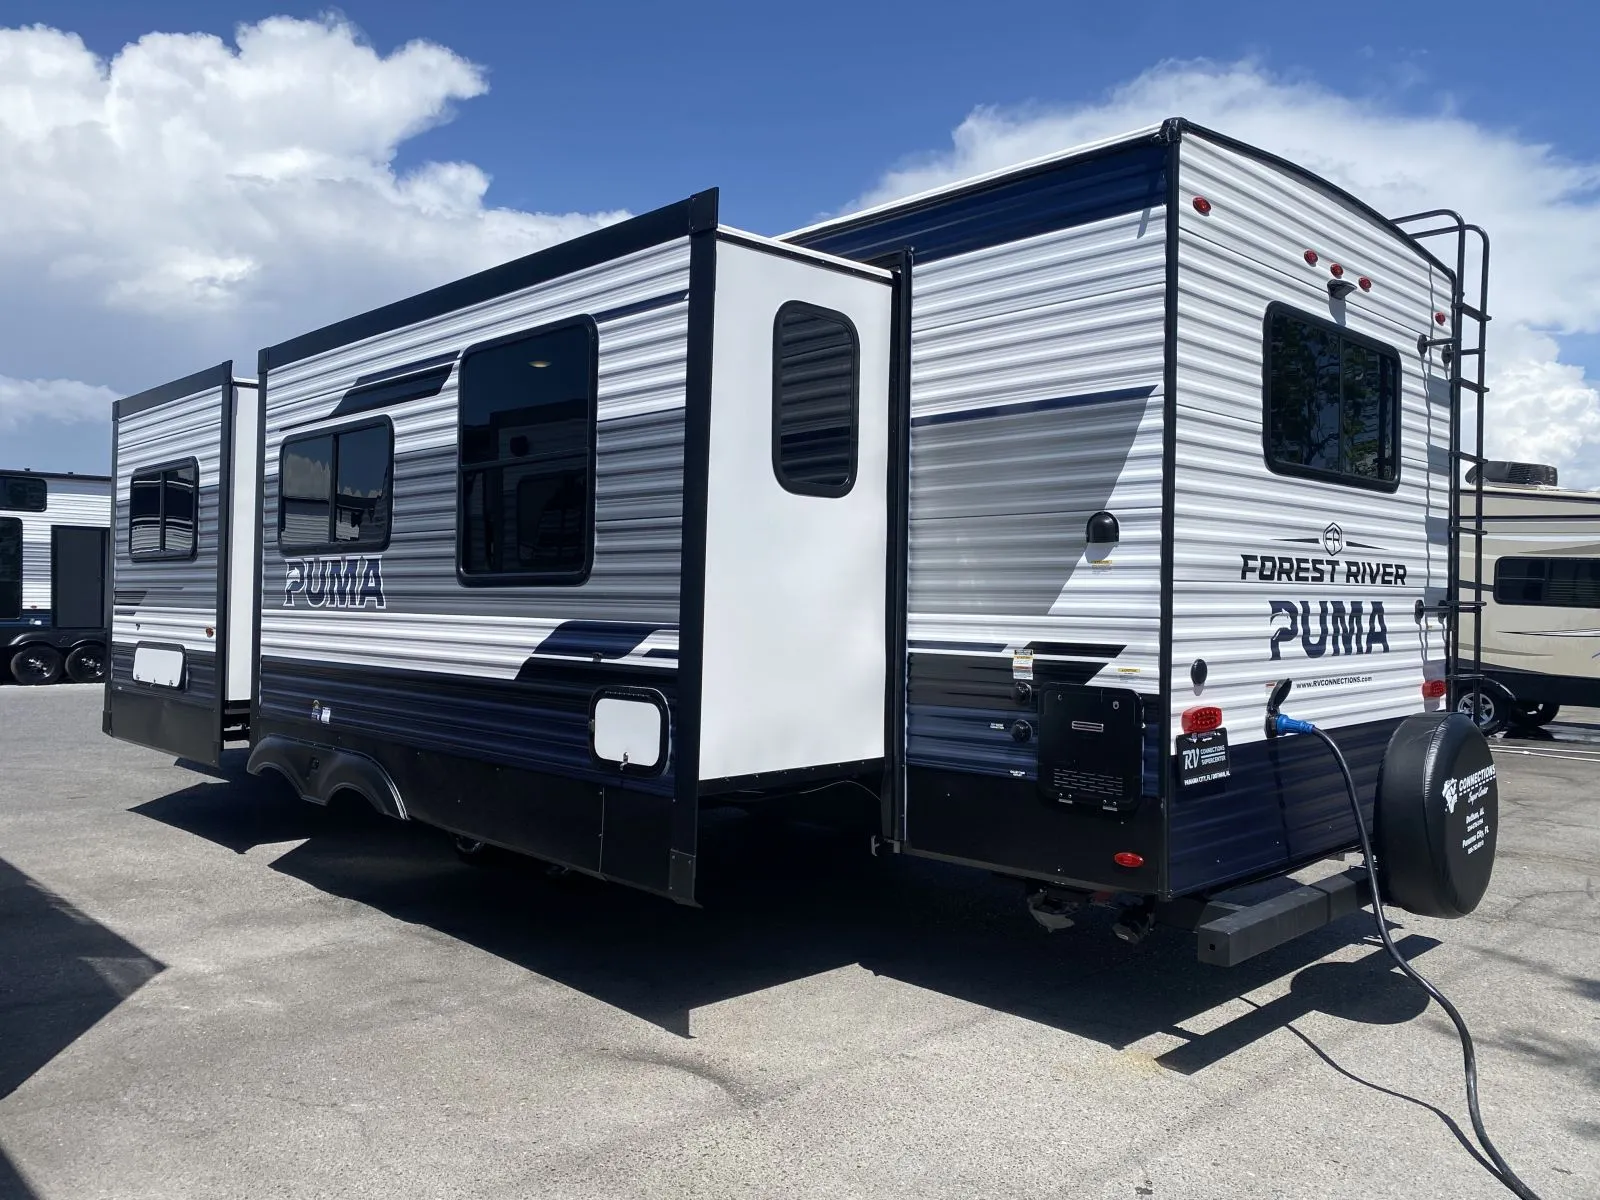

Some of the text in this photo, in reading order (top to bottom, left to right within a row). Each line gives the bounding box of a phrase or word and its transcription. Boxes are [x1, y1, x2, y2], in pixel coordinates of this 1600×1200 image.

[283, 555, 386, 609] PUMA
[1240, 554, 1407, 585] FOREST RIVER
[1268, 600, 1389, 660] PUMA
[1296, 676, 1372, 689] www.RVCONNECTIONS.com
[1182, 748, 1200, 770] RV
[1458, 763, 1496, 792] CONNECTIONS
